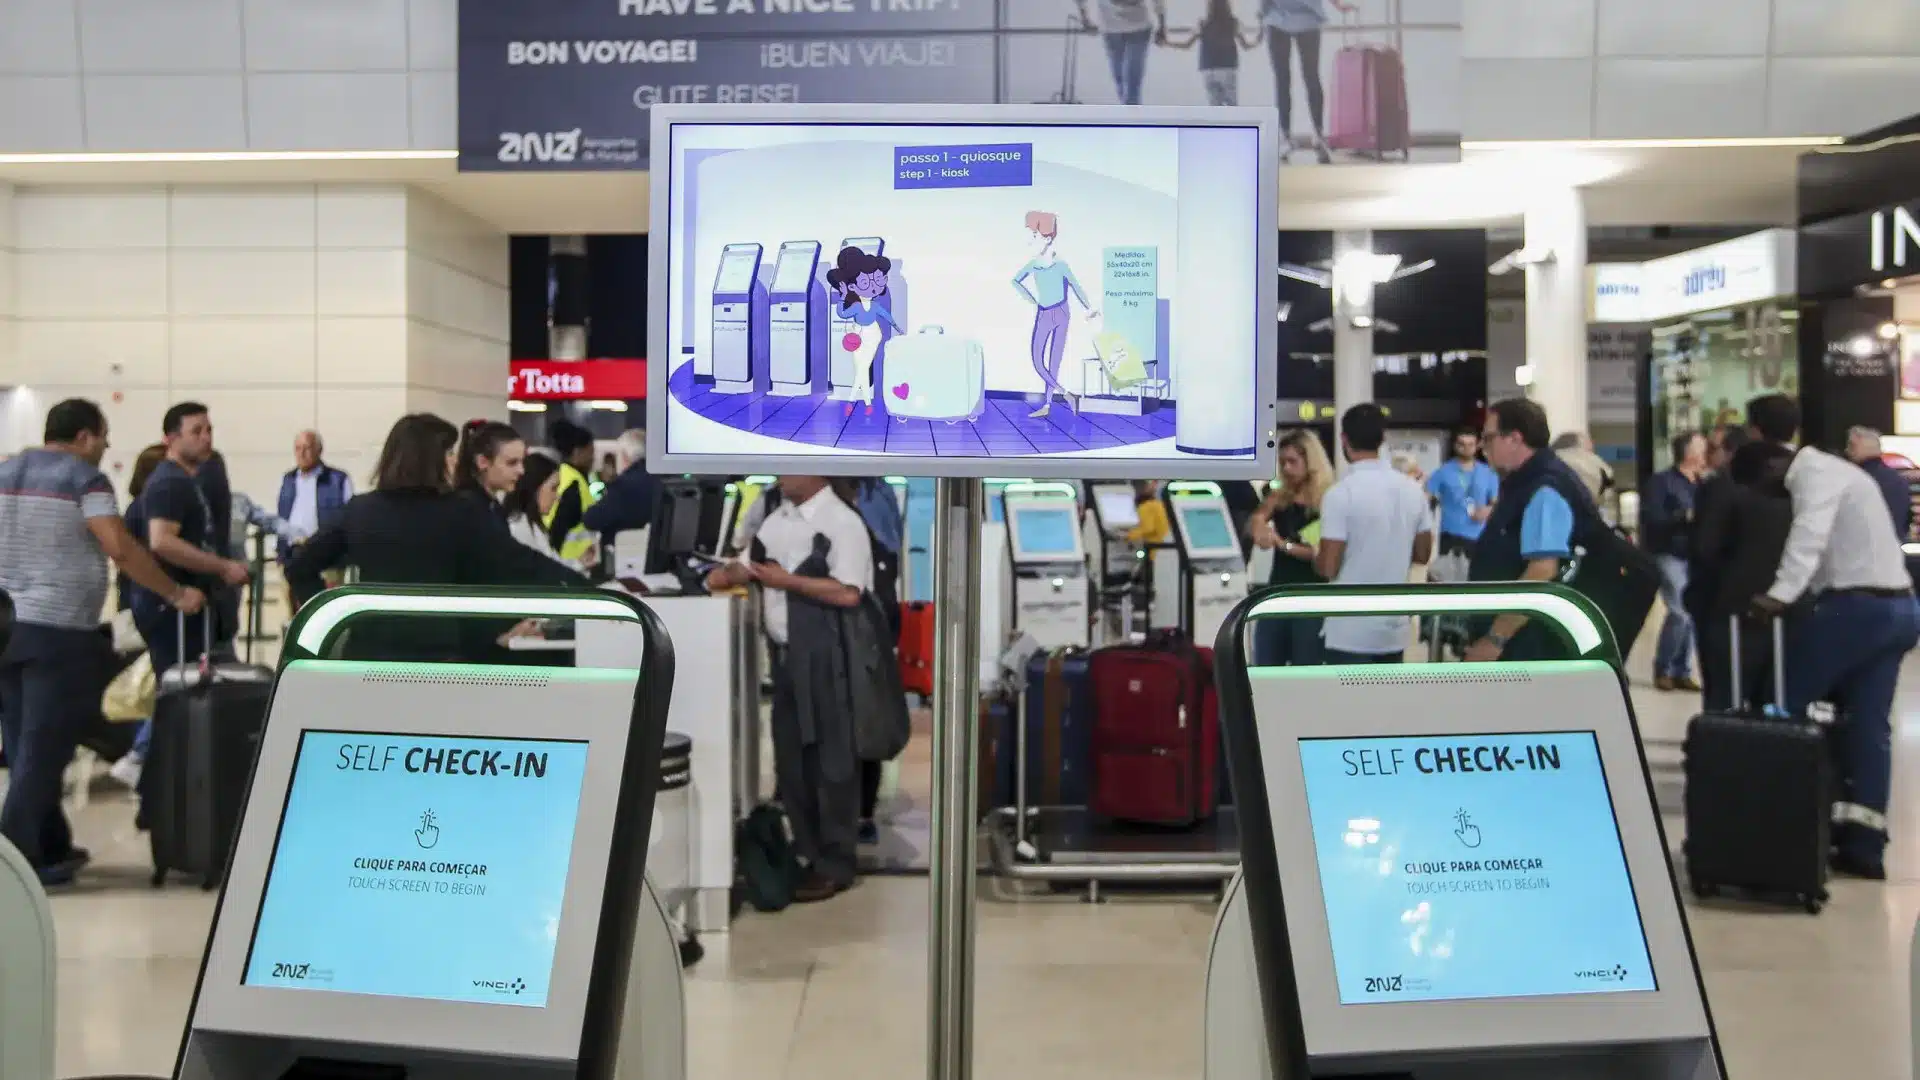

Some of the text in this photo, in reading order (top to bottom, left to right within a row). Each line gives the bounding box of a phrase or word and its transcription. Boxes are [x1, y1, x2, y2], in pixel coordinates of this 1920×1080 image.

[618, 0, 718, 16] HAVE
[726, 0, 755, 15] A
[508, 39, 698, 65] BON VOYAGE!
[900, 153, 939, 166] passo
[943, 152, 948, 162] 1
[960, 150, 1021, 164] quiosque
[900, 169, 924, 180] step
[927, 168, 931, 178] 1
[941, 168, 969, 178] kiosk
[1128, 299, 1139, 308] kg
[519, 368, 584, 394] Totta
[337, 743, 548, 778] SELF CHECK-IN
[1342, 744, 1561, 776] SELF CHECK-IN
[353, 857, 487, 879] CLIQUE PARA COMEÇAR
[1404, 858, 1543, 875] CLIQUE PARA COMEÇAR
[347, 876, 487, 896] TOUCH SCREEN TO BEGIN
[1405, 876, 1551, 895] TOUCH SCREEN TO BEGIN
[1574, 969, 1610, 978] VINCI
[472, 979, 508, 989] VINCI
